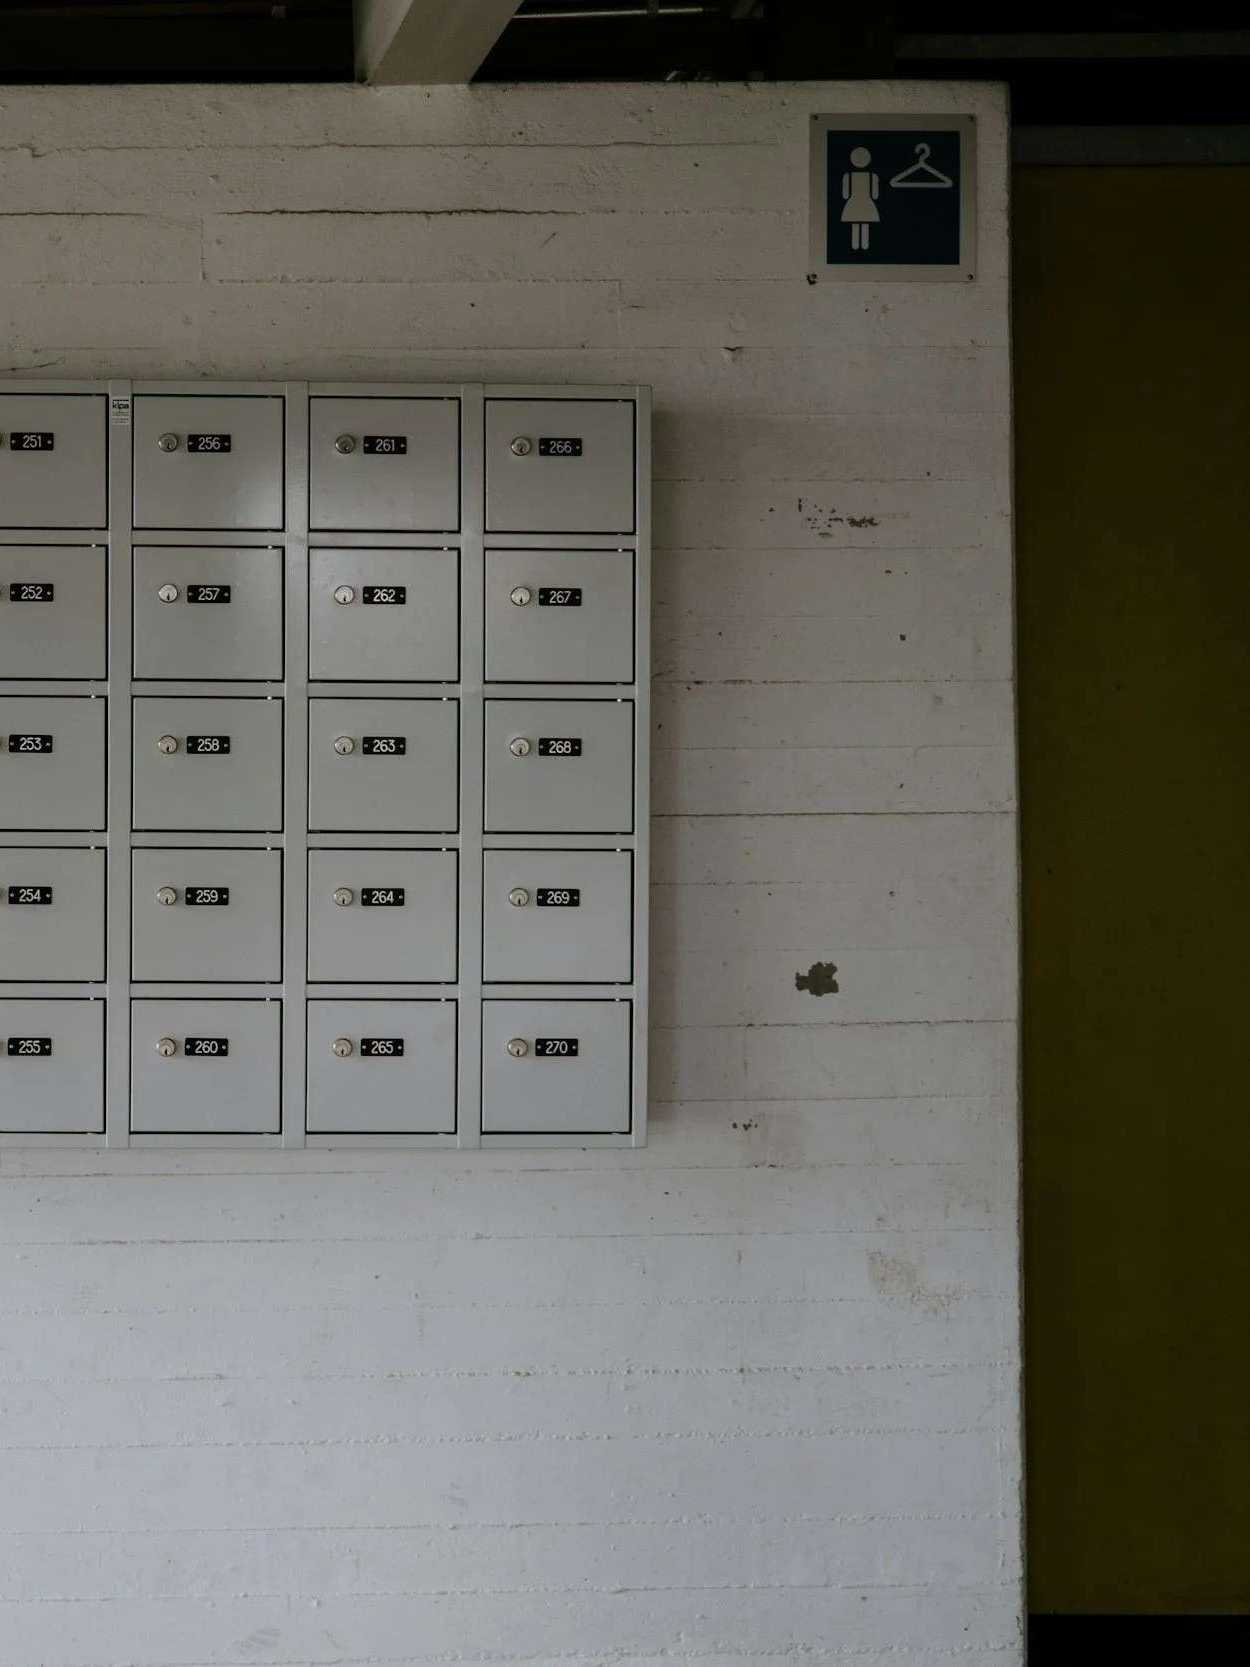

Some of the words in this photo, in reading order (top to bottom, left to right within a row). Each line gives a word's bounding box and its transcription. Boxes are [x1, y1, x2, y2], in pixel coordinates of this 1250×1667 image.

[22, 434, 42, 449] 251
[198, 436, 221, 450] 256
[375, 438, 395, 452] 261
[549, 440, 573, 454] 266
[20, 585, 43, 600] 252
[197, 587, 221, 601] 257
[373, 588, 396, 603] 262
[549, 590, 572, 604] 267
[19, 736, 42, 751] 253
[197, 738, 220, 752] 258
[372, 739, 396, 753] 263
[548, 740, 572, 754] 268
[18, 888, 42, 902] 254
[195, 889, 219, 903] 259
[371, 890, 395, 904] 264
[546, 890, 570, 905] 269
[18, 1040, 41, 1054] 255
[194, 1040, 219, 1054] 260
[370, 1040, 394, 1054] 265
[545, 1040, 569, 1054] 270
